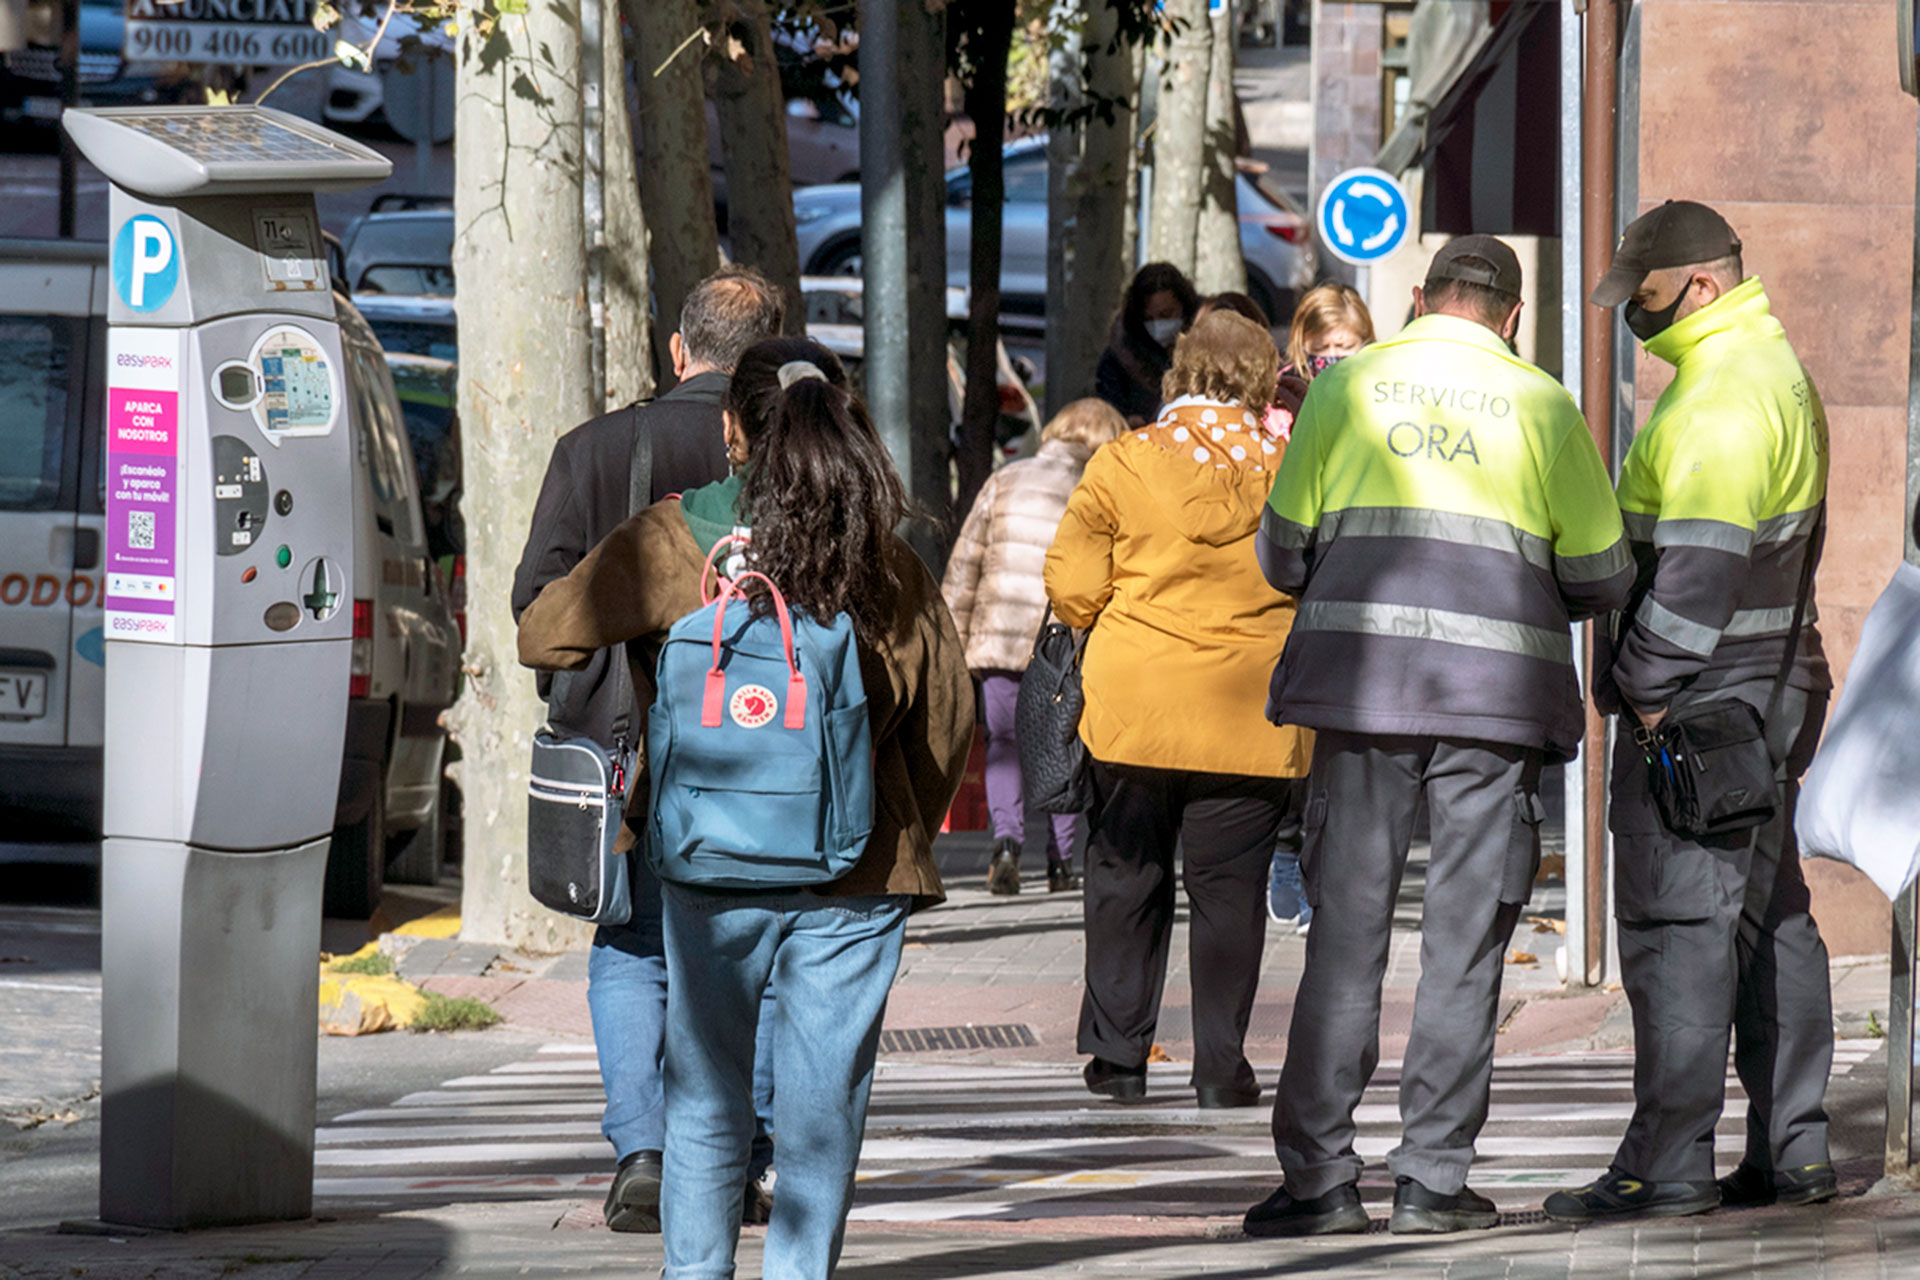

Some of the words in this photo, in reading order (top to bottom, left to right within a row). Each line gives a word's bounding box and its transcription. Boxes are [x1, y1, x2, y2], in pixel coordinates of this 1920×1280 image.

[135, 27, 192, 56] 900
[203, 28, 261, 58] 406
[271, 31, 329, 59] 600
[131, 220, 172, 306] P
[124, 401, 163, 414] APARCA
[1374, 381, 1511, 418] SERVICIO
[117, 428, 169, 443] NOSOTROS
[132, 415, 155, 428] CON
[1387, 421, 1480, 465] ORA
